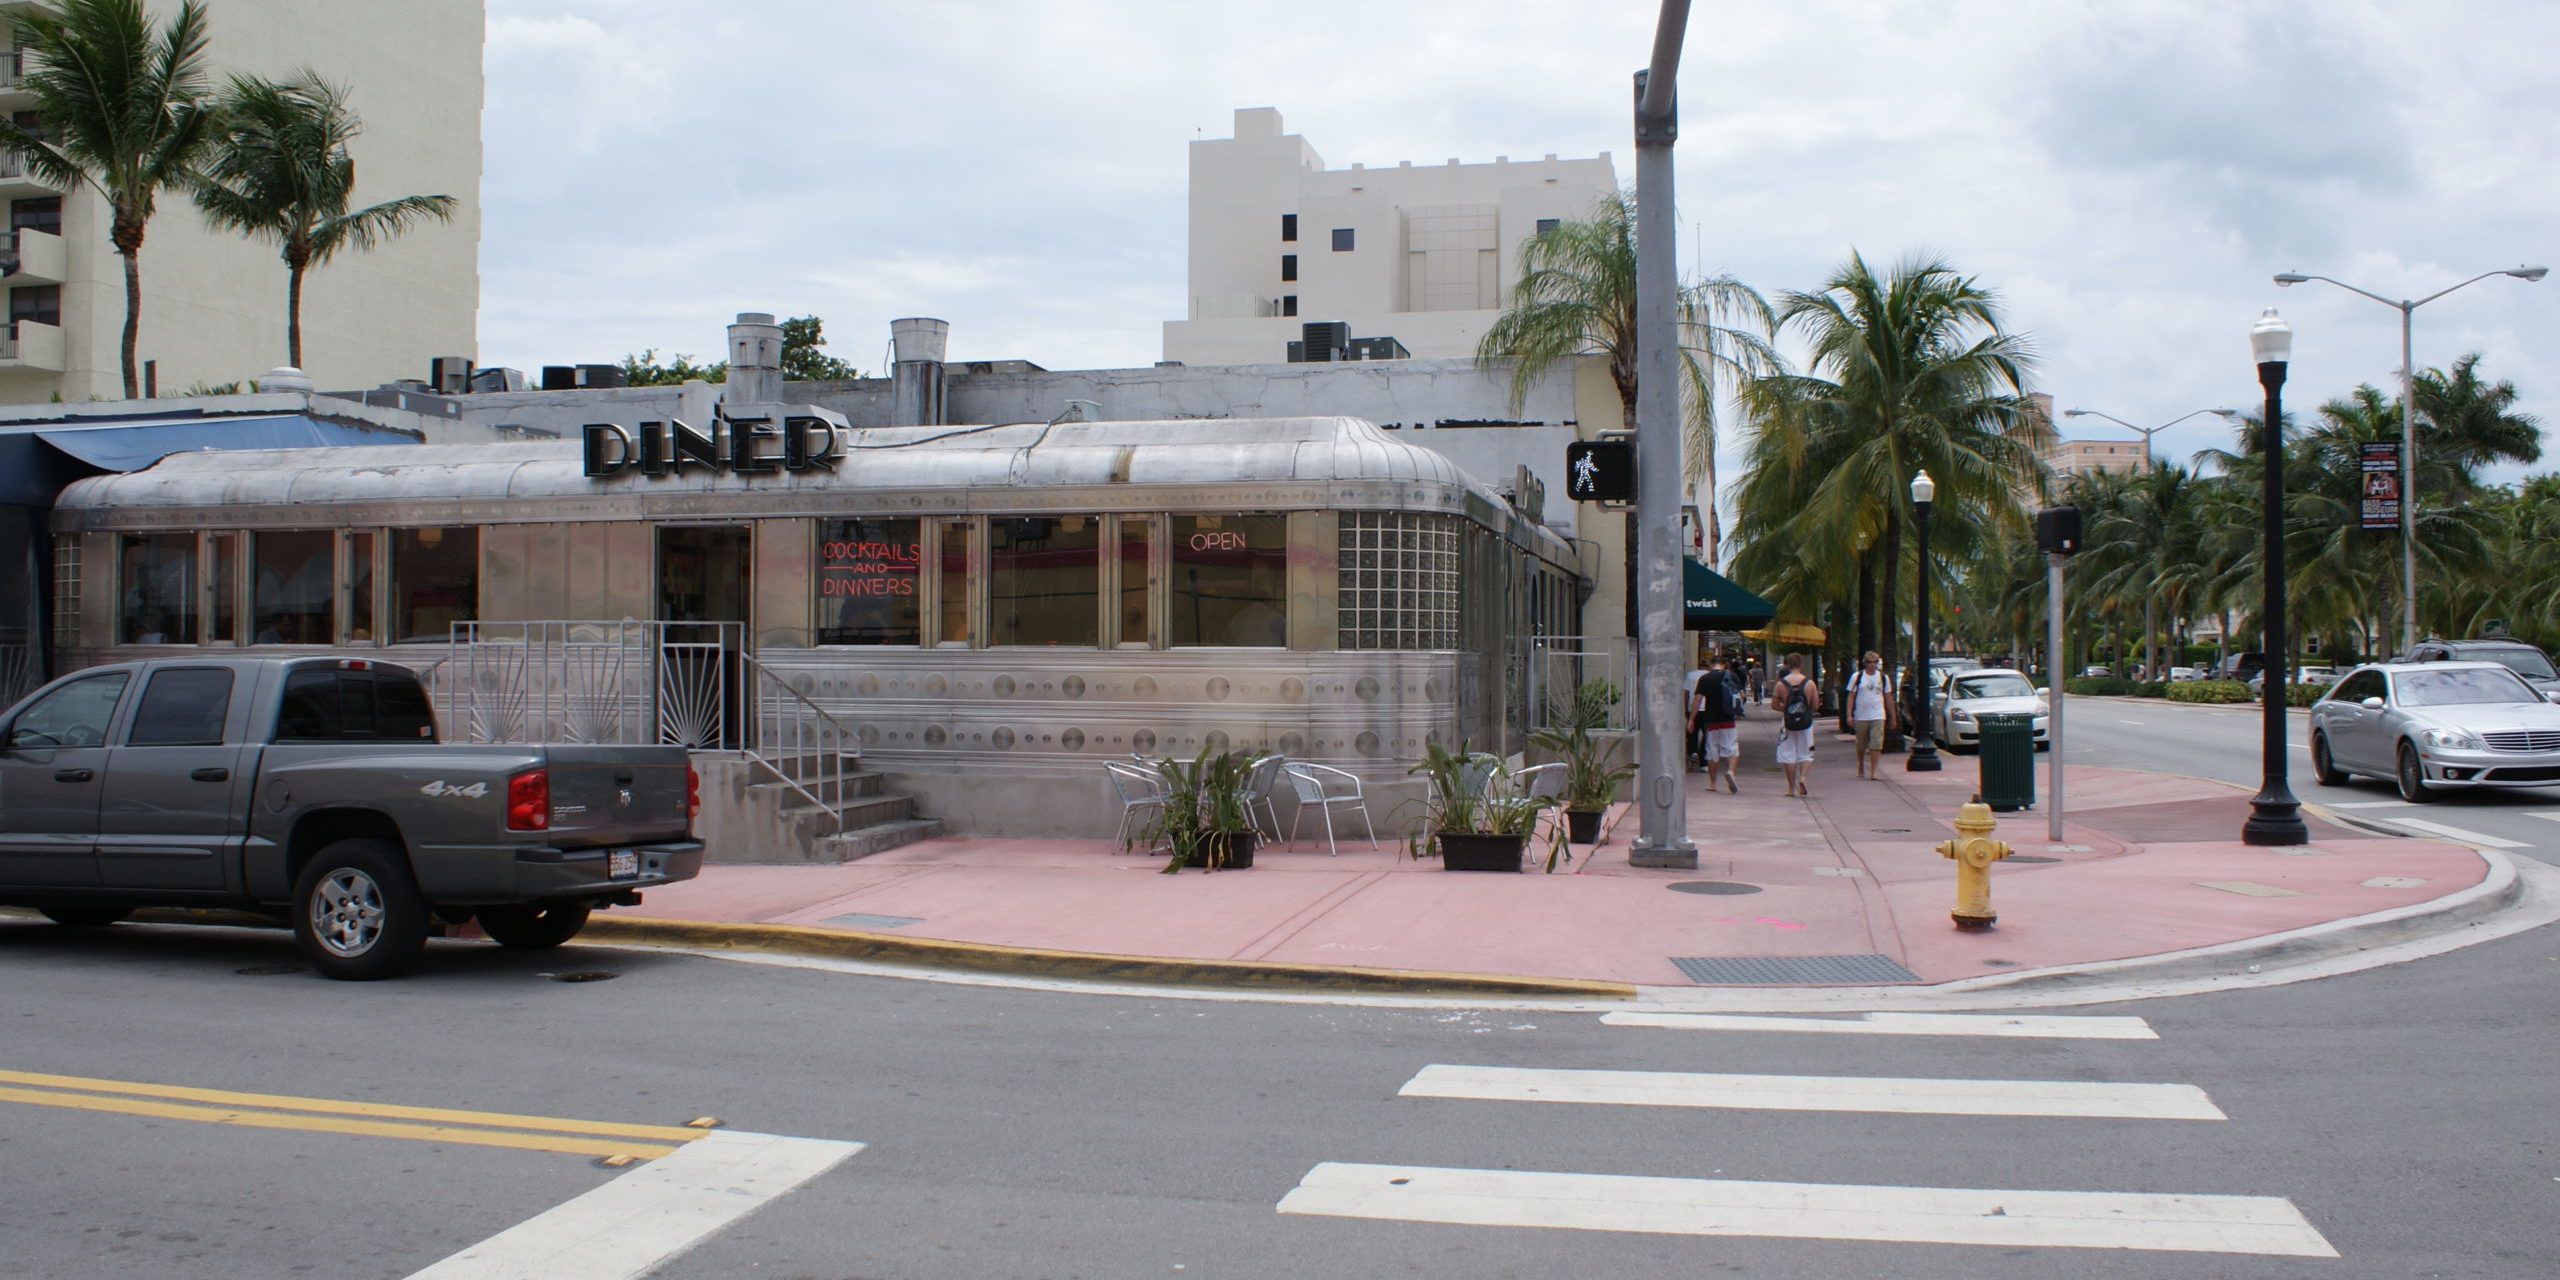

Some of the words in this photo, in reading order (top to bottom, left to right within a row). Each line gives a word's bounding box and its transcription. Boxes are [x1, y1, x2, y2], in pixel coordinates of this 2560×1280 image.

[583, 415, 837, 477] DINER
[1190, 532, 1246, 551] OPEN
[823, 542, 921, 561] COCKTAILS
[852, 562, 888, 574] AND
[823, 578, 913, 596] DINNERS
[1686, 598, 1719, 608] twist
[420, 780, 489, 798] 4x4
